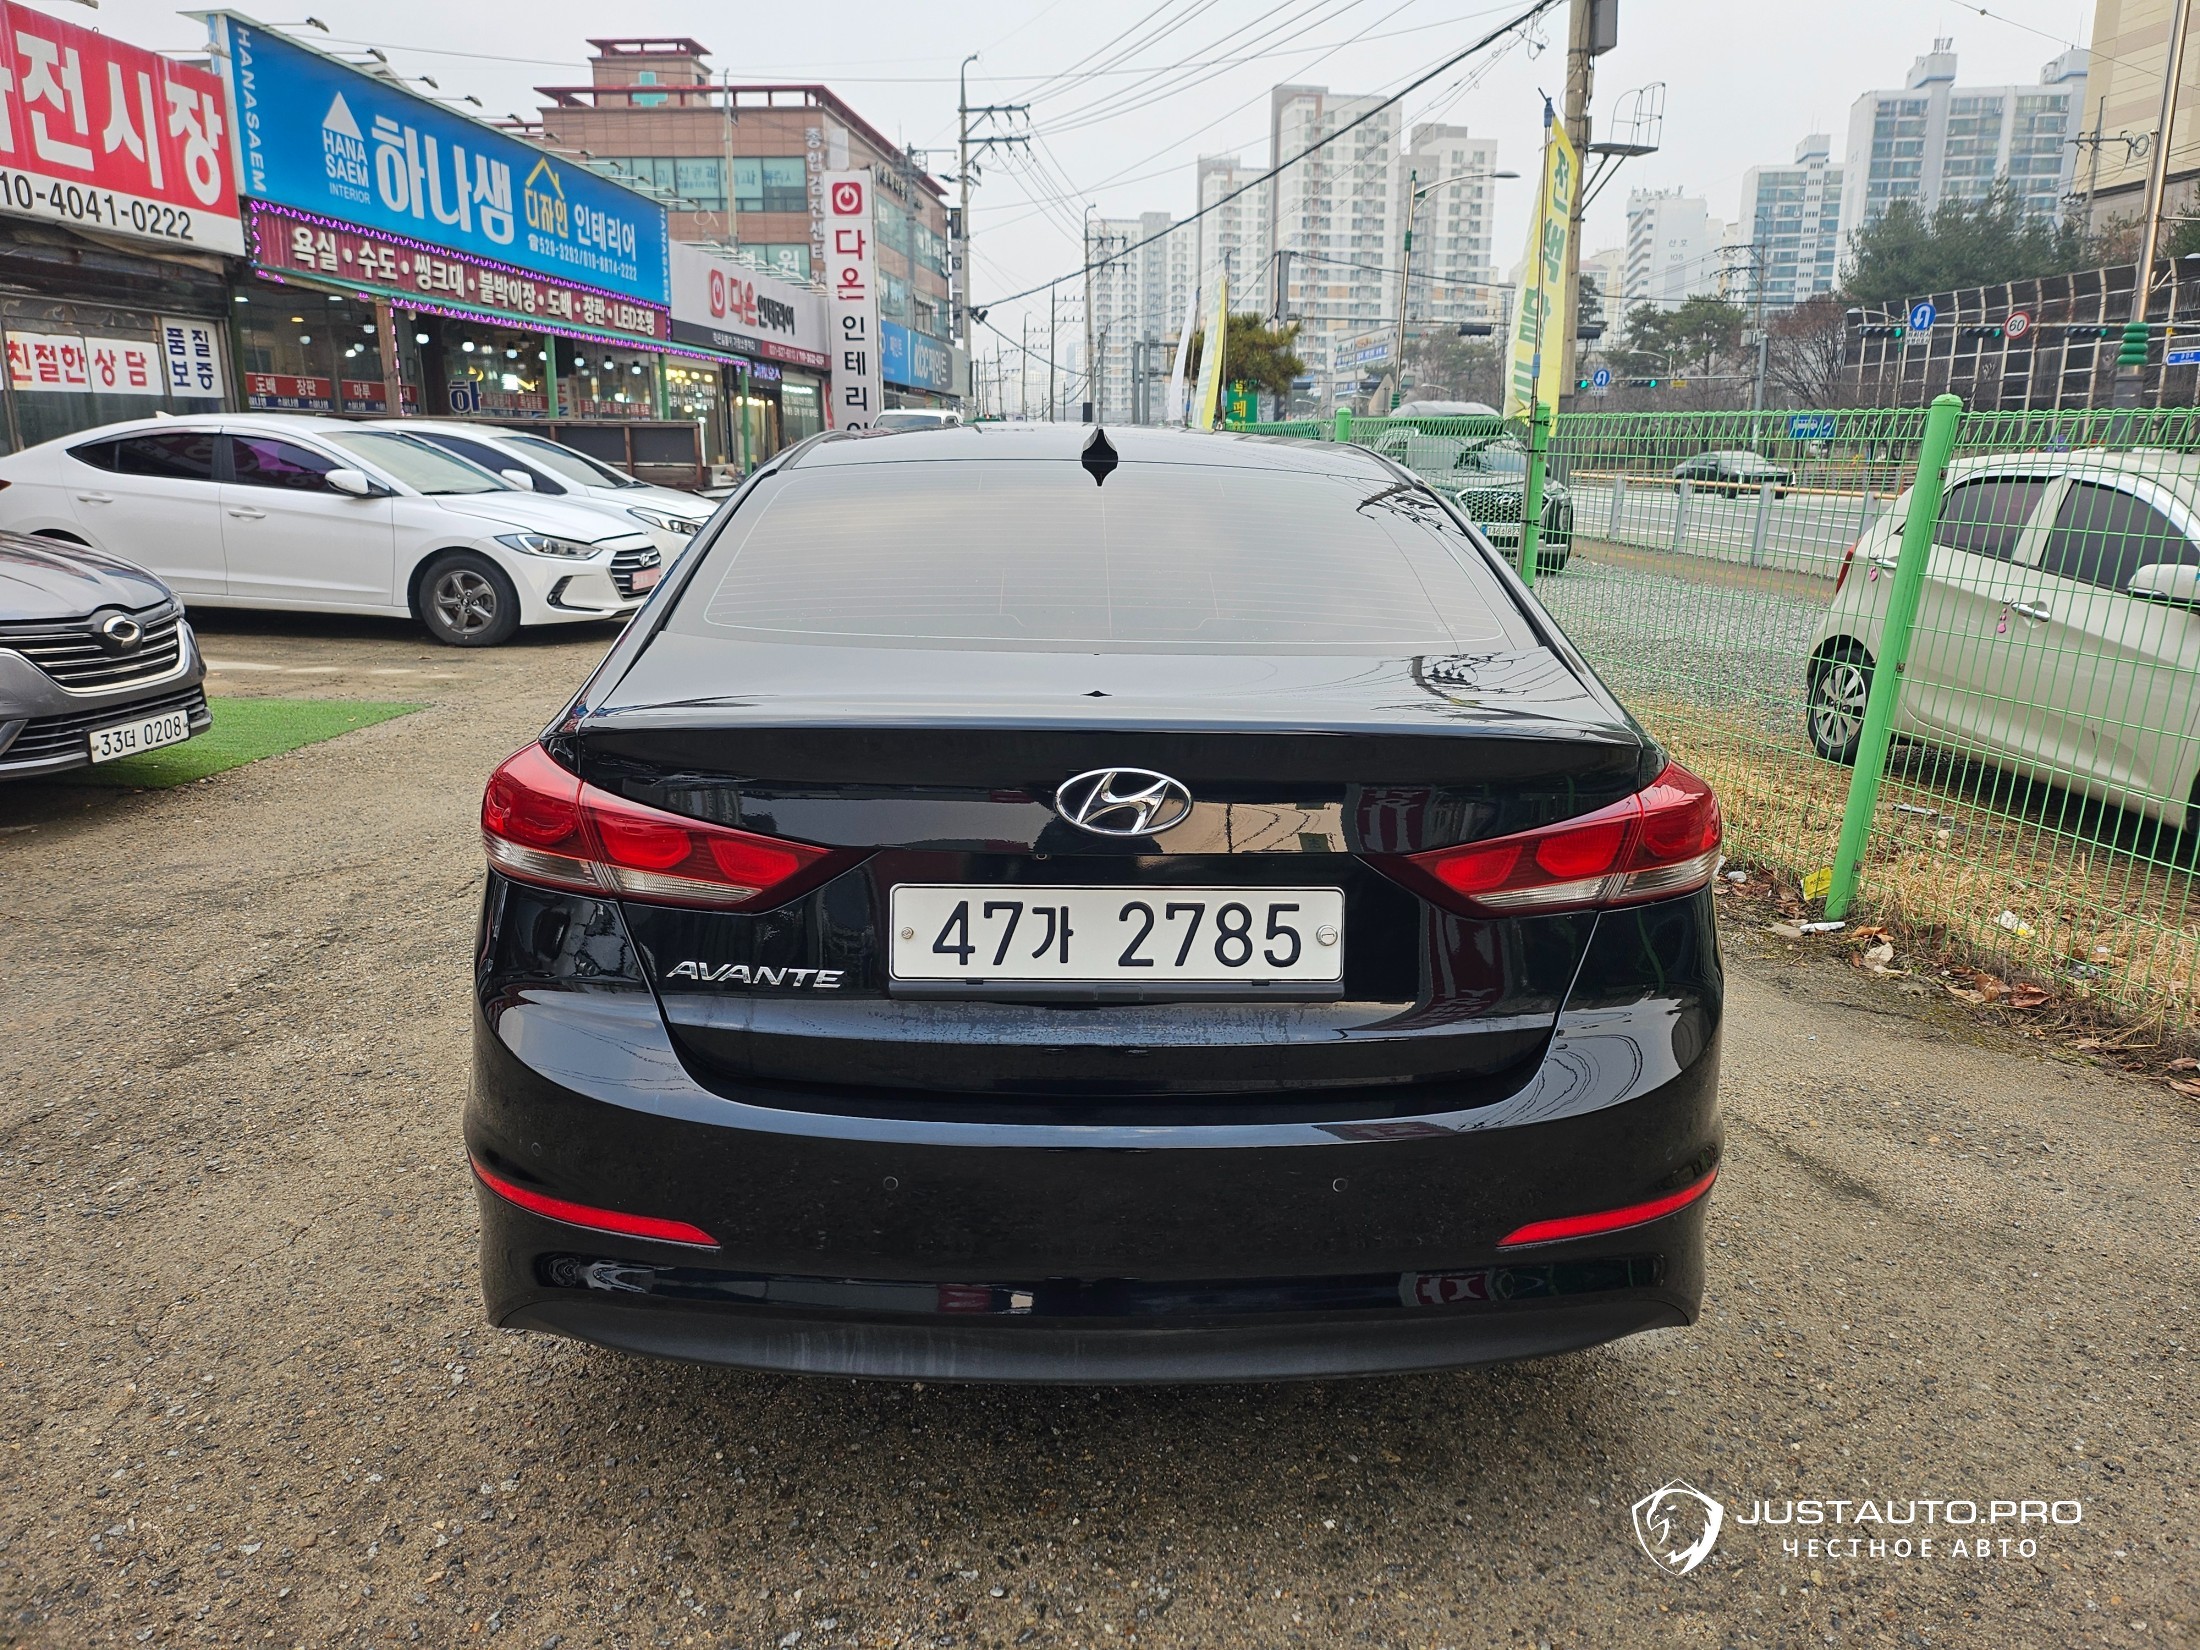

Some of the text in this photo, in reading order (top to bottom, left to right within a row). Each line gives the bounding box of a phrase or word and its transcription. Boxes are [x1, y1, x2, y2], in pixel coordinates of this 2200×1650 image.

[237, 26, 267, 192] HANASAEM
[322, 128, 366, 163] HANA
[325, 153, 369, 188] SAEM
[371, 114, 515, 245] 하나샘
[330, 182, 371, 205] INTERIOR
[524, 187, 637, 261] 디자인 인테리어
[292, 227, 655, 336] 욕실 수도 씽크대 붙박이장 도배 장판 LED조명
[835, 229, 866, 300] 다온
[729, 277, 795, 336] 다온 인테리어
[2010, 319, 2025, 332] 60
[166, 327, 211, 358] 품질
[6, 339, 148, 387] 친절한 상담
[172, 361, 214, 390] 보증
[449, 379, 483, 414] 하
[100, 716, 182, 756] 33더 0208
[932, 900, 1301, 968] 47가 2785
[665, 960, 845, 989] AVANTE
